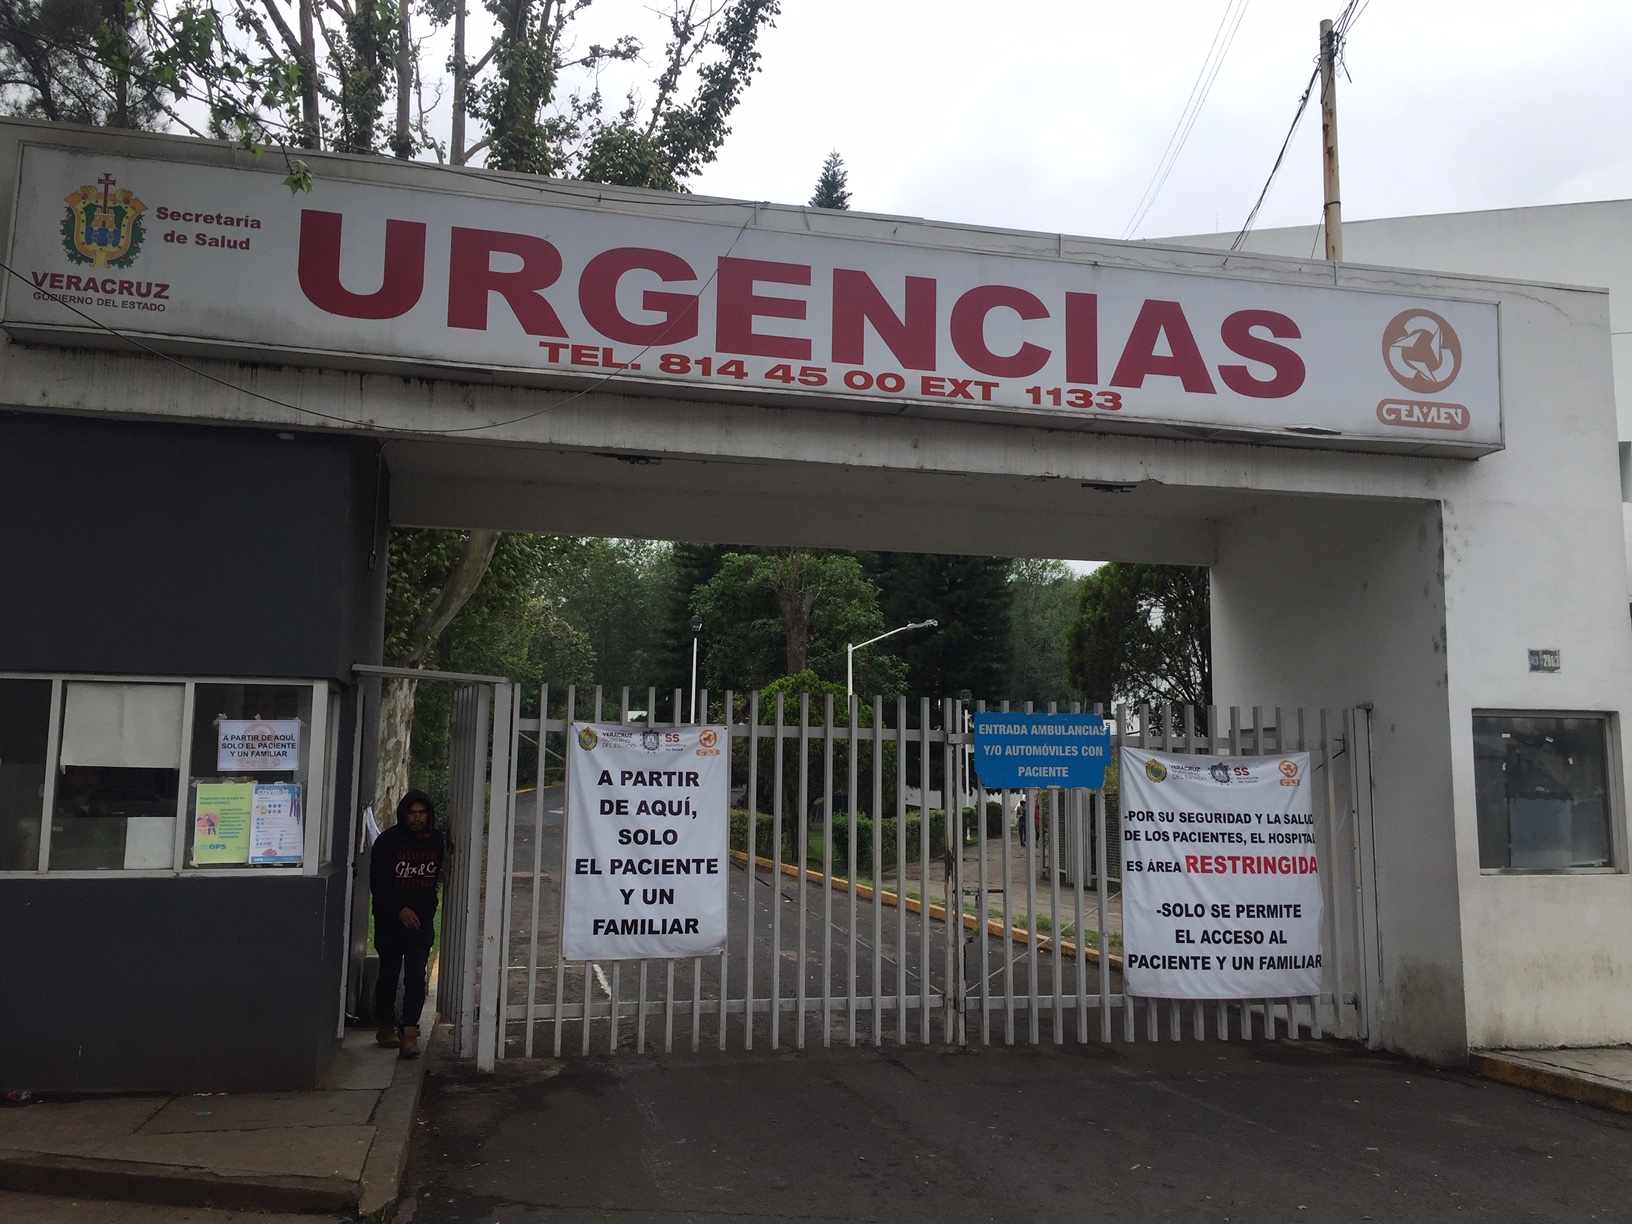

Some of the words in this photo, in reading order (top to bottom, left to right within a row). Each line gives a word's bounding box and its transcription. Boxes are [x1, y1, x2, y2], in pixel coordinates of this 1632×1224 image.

[156, 206, 261, 229] Secretaría
[163, 231, 188, 244] de
[195, 233, 250, 250] Salud
[31, 272, 170, 300] VERACRUZ
[33, 292, 93, 305] GOBIERNO
[96, 297, 119, 308] DEL
[121, 300, 166, 312] ESTADO
[298, 208, 1306, 398] URGENCIAS
[538, 341, 641, 371] TEL.
[659, 353, 748, 379] 814
[764, 363, 828, 387] 45
[843, 370, 905, 393] 00
[921, 376, 1000, 401] EXT
[1026, 386, 1123, 411] 1133
[665, 733, 680, 743] SS
[979, 724, 1028, 735] ENTRADA
[1030, 724, 1107, 736] AMBULANCIAS
[983, 745, 1002, 756] Y/O
[1005, 743, 1078, 756] AUTOMÓVILES
[1081, 745, 1103, 757] CON
[597, 770, 613, 786] A
[620, 770, 700, 787] PARTIR
[1018, 766, 1069, 777] PACIENTE
[1233, 767, 1250, 776] SS
[599, 799, 629, 816] DE
[636, 796, 698, 819] AQUÍ,
[1124, 811, 1154, 822] -POR
[1158, 811, 1175, 823] SU
[1179, 812, 1251, 824] SEGURIDAD
[1255, 813, 1263, 824] Y
[1266, 813, 1281, 824] LA
[618, 828, 678, 845] SOLO
[1124, 830, 1141, 841] DE
[1145, 830, 1170, 842] LOS
[1173, 831, 1247, 846] PACIENTES,
[1251, 832, 1265, 844] EL
[575, 858, 602, 875] EL
[610, 858, 719, 875] PACIENTE
[1126, 860, 1143, 872] ES
[1147, 859, 1182, 873] ÁREA
[1185, 855, 1318, 875] RESTRINGIDA
[619, 888, 635, 905] Y
[642, 888, 674, 905] UN
[1156, 903, 1205, 918] -SOLO
[1210, 904, 1230, 918] SE
[1236, 904, 1302, 918] PERMITE
[592, 918, 699, 935] FAMILIAR
[1175, 929, 1195, 944] EL
[1200, 929, 1264, 944] ACCESO
[1268, 930, 1287, 944] AL
[1128, 954, 1211, 970] PACIENTE
[1215, 956, 1227, 970] Y
[1232, 956, 1254, 971] UN
[1259, 954, 1322, 970] FAMILIAR
